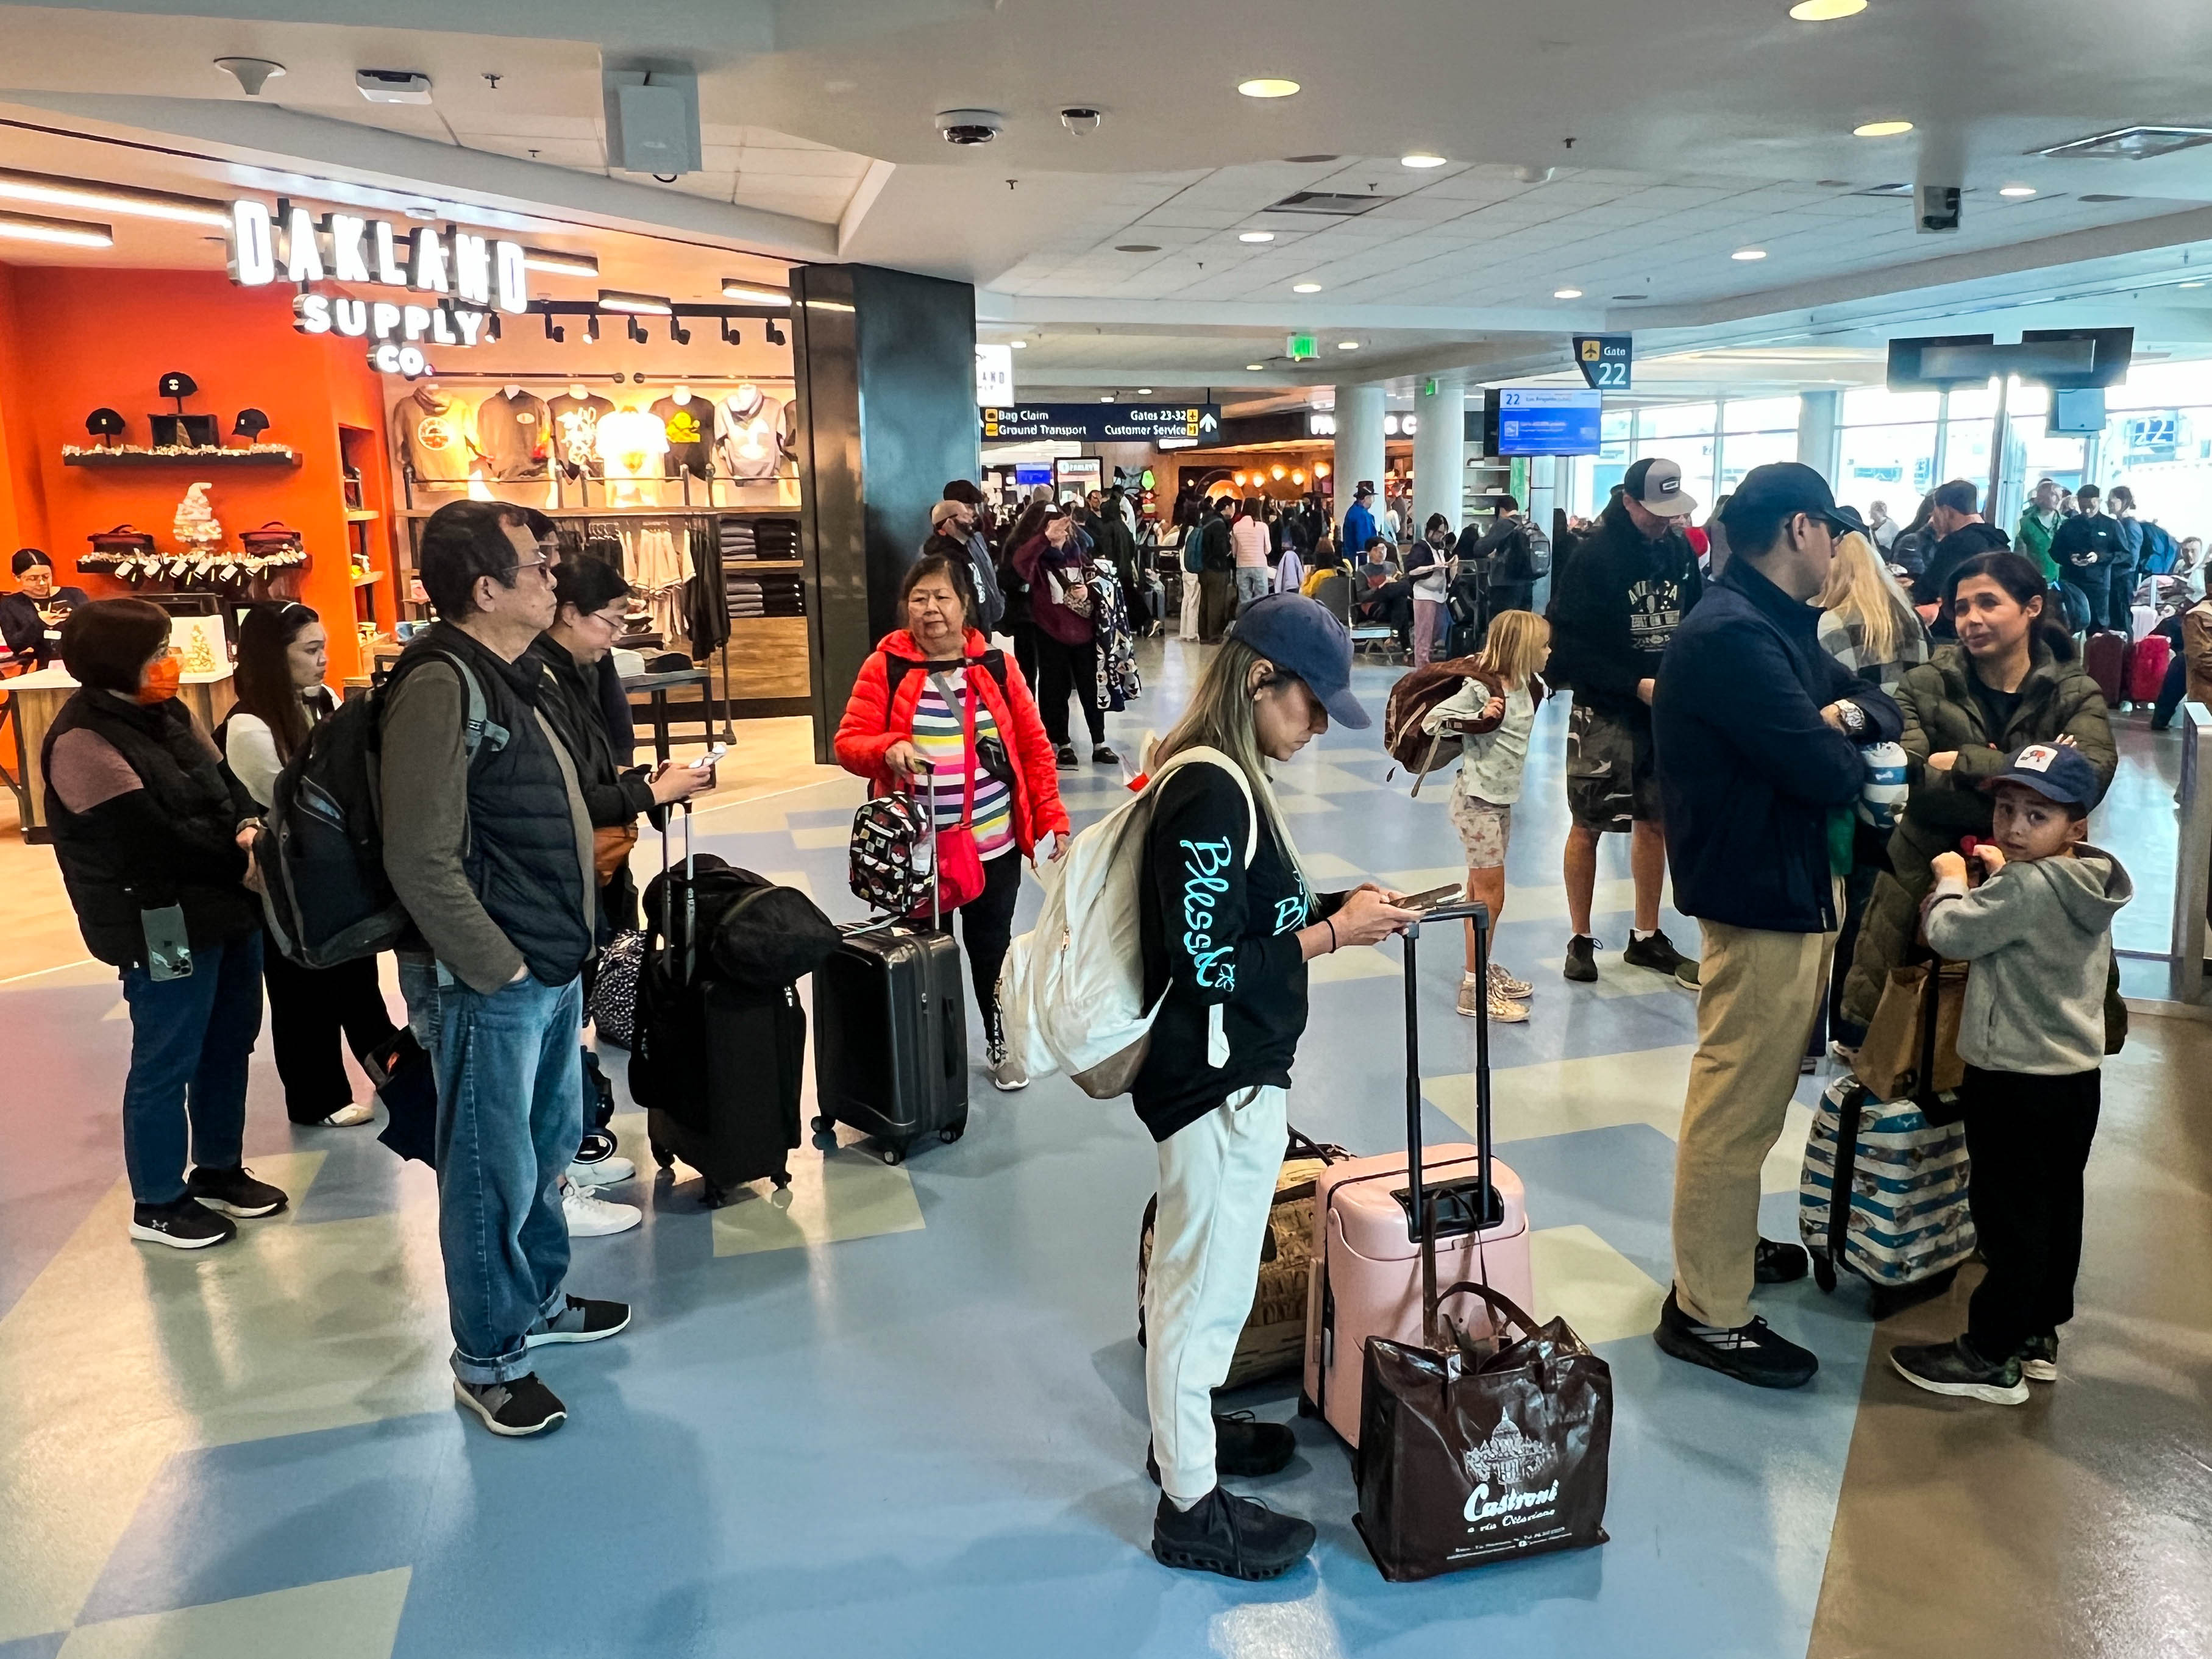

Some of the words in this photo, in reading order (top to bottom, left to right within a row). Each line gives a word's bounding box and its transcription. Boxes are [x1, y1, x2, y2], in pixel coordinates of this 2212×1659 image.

[234, 200, 527, 314] OAKLAND
[304, 295, 483, 346] SUPPLY
[1604, 346, 1626, 356] Gate
[1598, 363, 1626, 385] 22
[1506, 394, 1520, 405] 22
[998, 410, 1018, 423] Bag
[1020, 410, 1048, 421] Claim
[1131, 410, 1158, 421] Gates
[1159, 410, 1186, 421] 23-32
[999, 424, 1037, 435] Ground
[1039, 424, 1087, 436] Transport
[1104, 424, 1151, 435] Customer
[1153, 424, 1186, 435] Service
[2135, 418, 2168, 446] 22
[1463, 1479, 1559, 1522] Castroni
